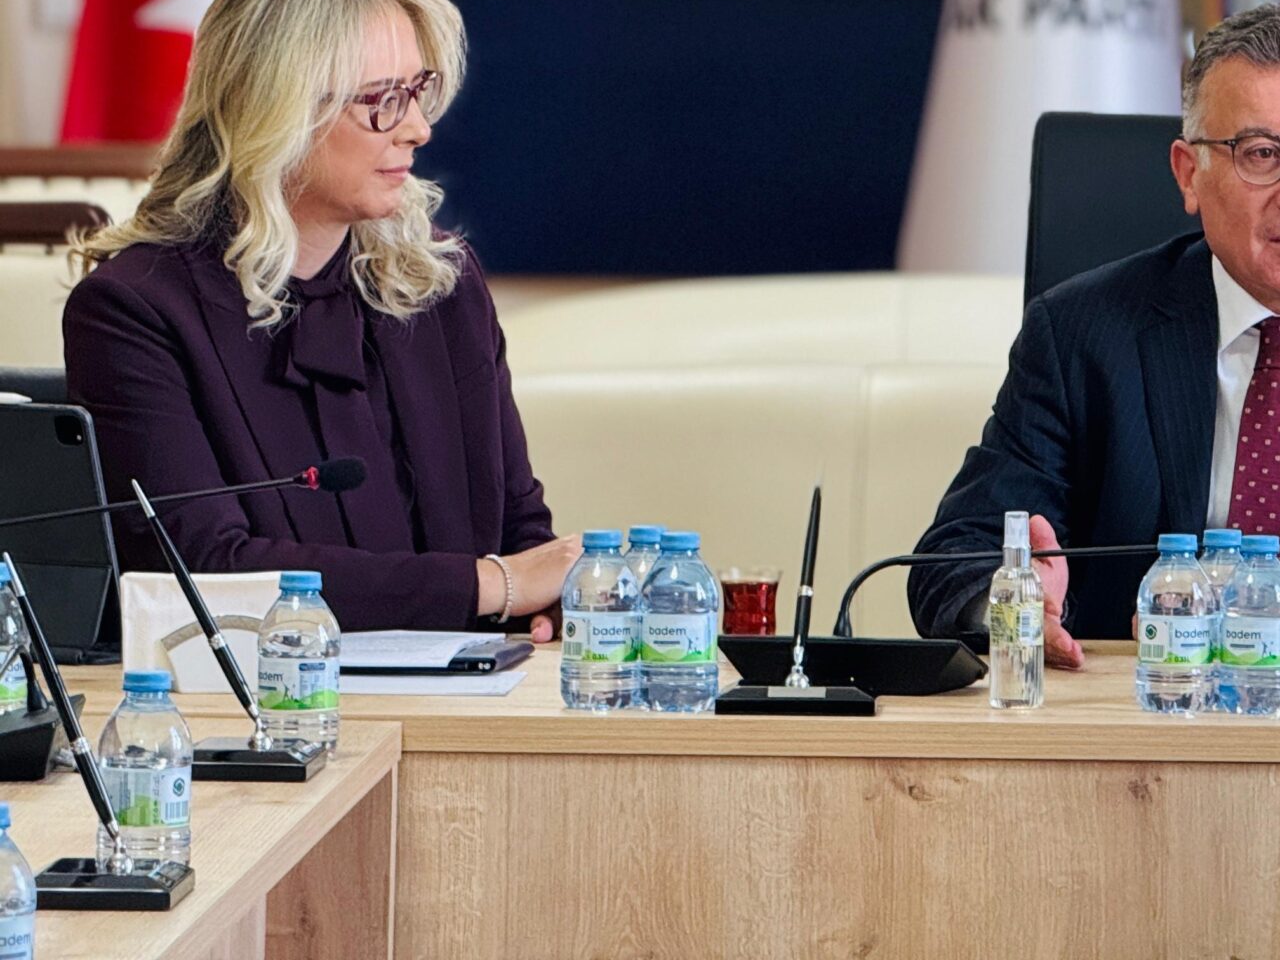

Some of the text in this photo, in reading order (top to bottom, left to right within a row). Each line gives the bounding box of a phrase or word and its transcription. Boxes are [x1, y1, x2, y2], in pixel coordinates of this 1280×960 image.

[592, 626, 631, 636] badem
[649, 626, 687, 636] badem
[1174, 629, 1210, 639] badem
[1226, 629, 1261, 640] badem
[0, 933, 31, 947] adem
